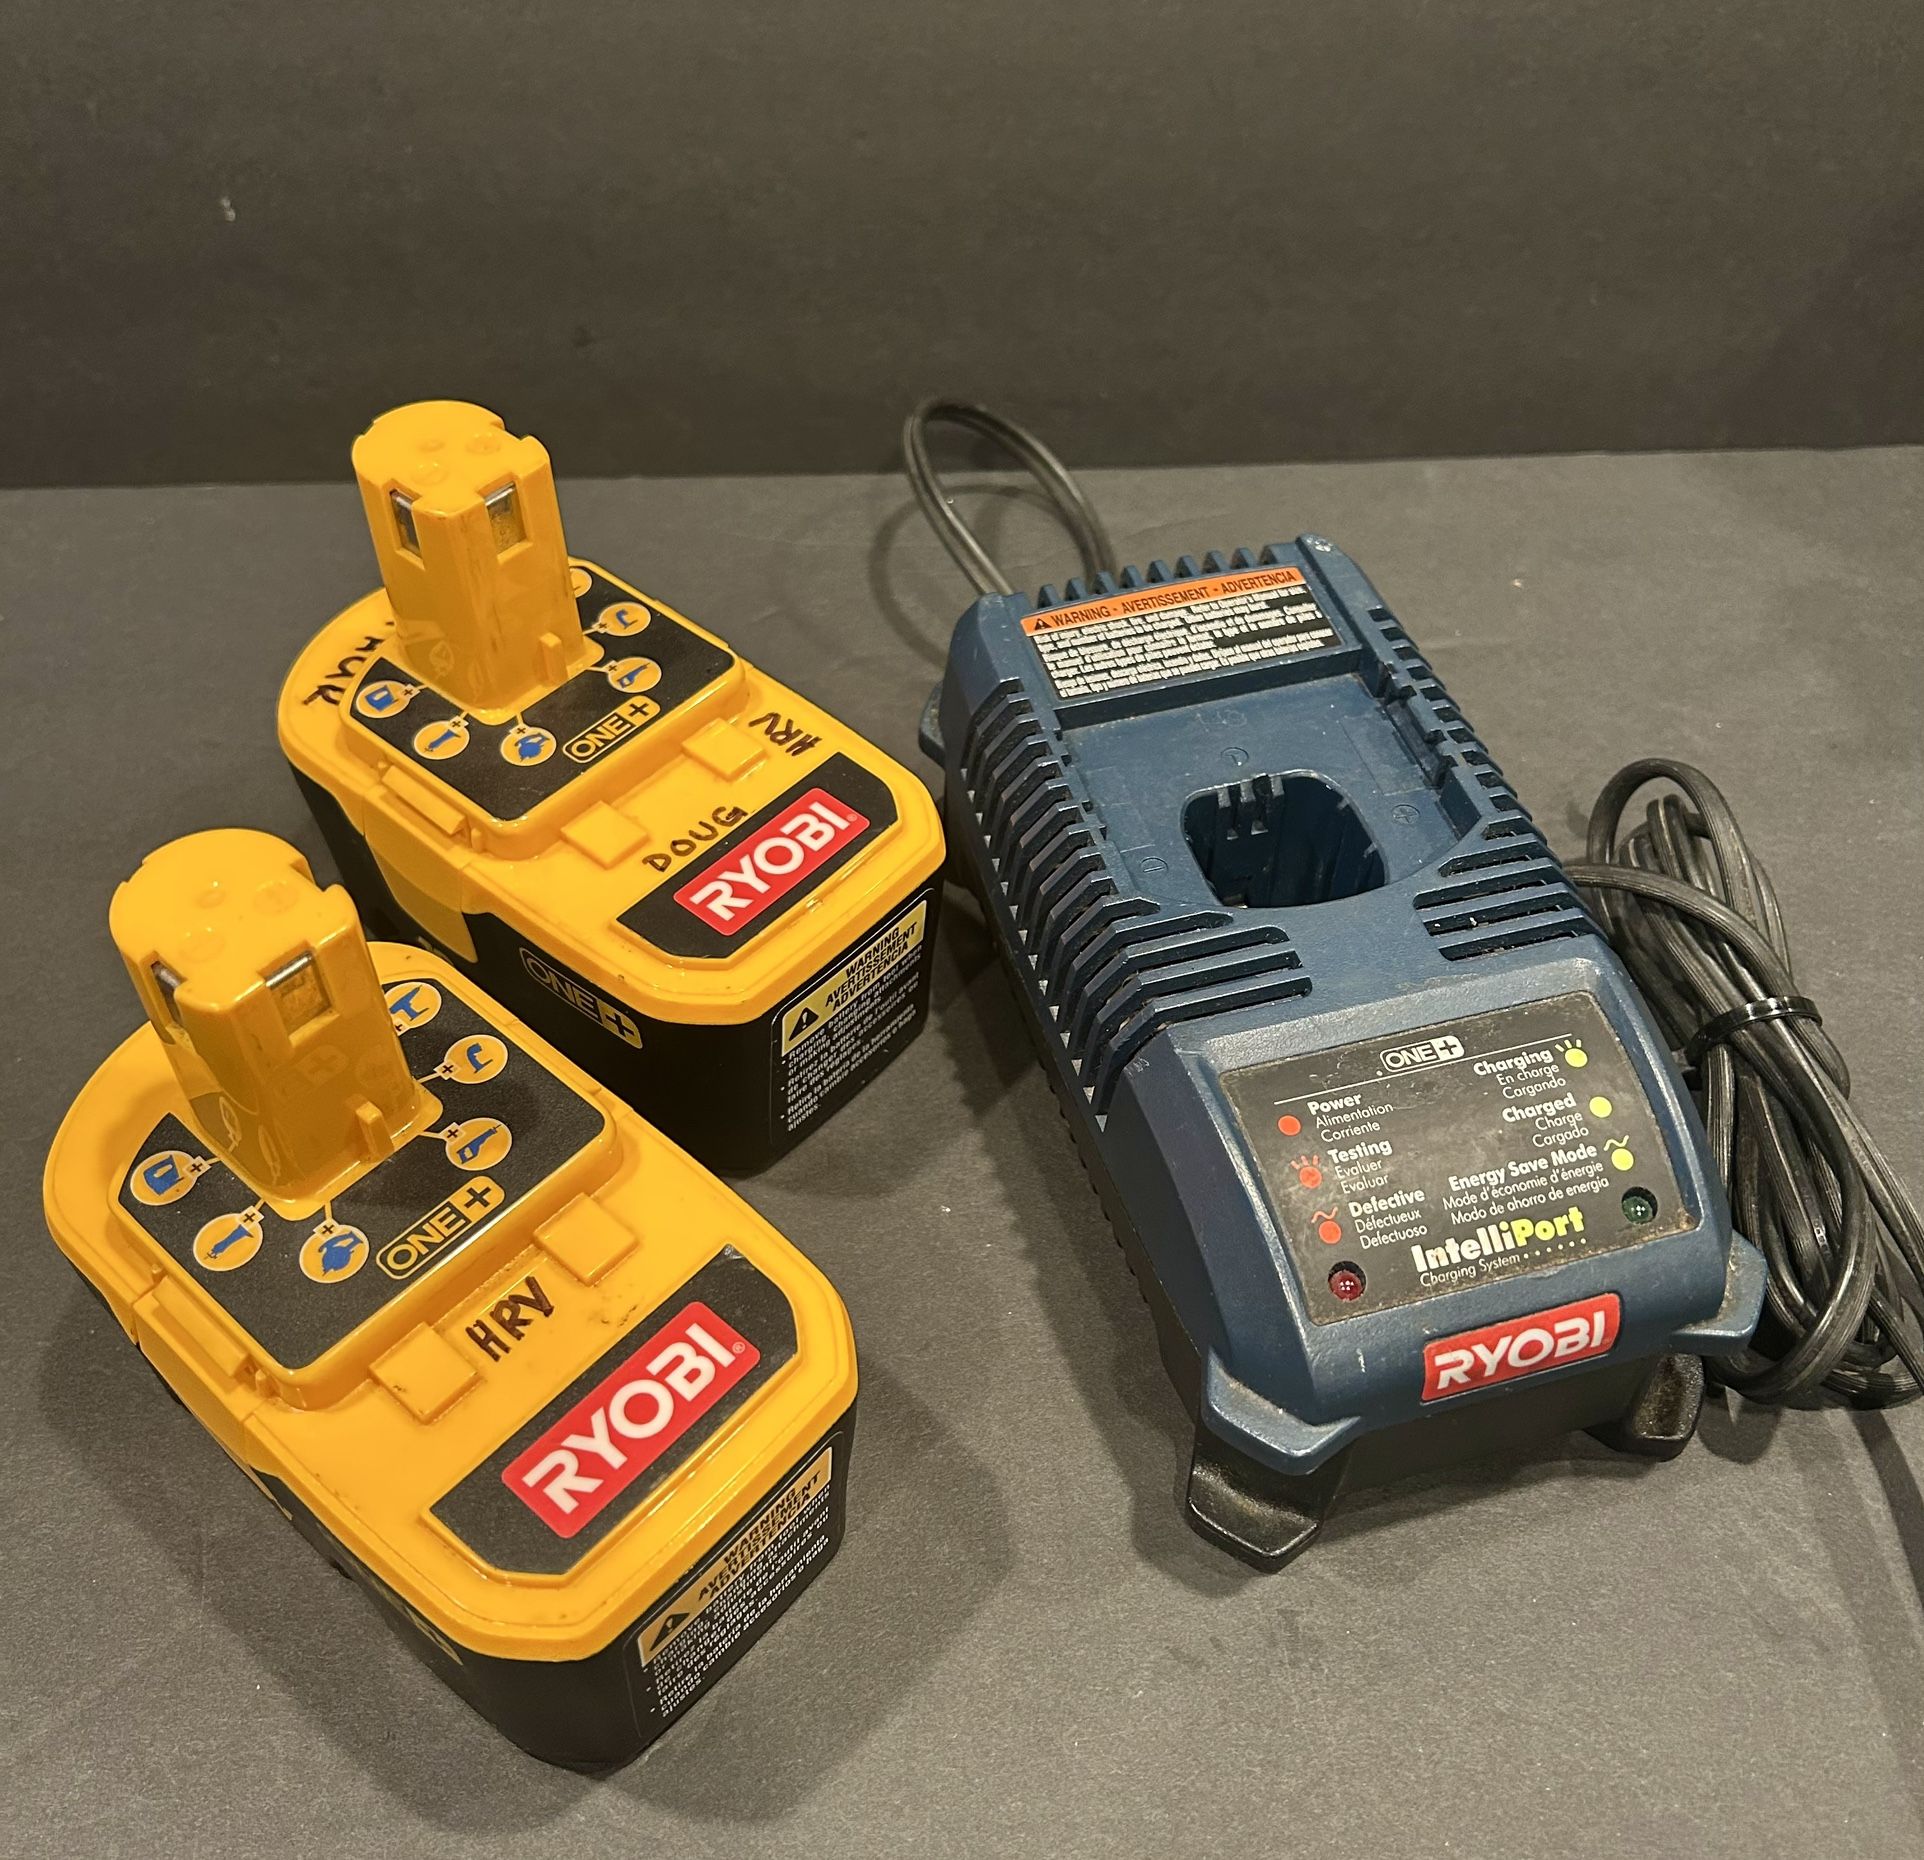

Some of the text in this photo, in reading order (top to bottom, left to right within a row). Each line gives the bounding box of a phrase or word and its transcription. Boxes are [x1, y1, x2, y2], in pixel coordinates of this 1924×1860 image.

[1051, 571, 1297, 628] WARNING AVERTISSEMENT ADVERTENCIA
[642, 805, 749, 873] DOUG
[689, 801, 850, 922] RYOBI
[825, 922, 916, 1006] AVERTISSEMENT
[846, 927, 898, 977] WARNING
[832, 941, 907, 1010] ADVERTENCIA
[1473, 1050, 1553, 1075] Charging
[1495, 1061, 1559, 1085] En charge
[1307, 1094, 1360, 1114] Power
[1502, 1075, 1565, 1098] Cargando
[1316, 1104, 1393, 1128] Alimentation
[1502, 1092, 1576, 1121] Charged
[1320, 1121, 1380, 1142] Corriente
[1532, 1124, 1588, 1147] Cargado
[1327, 1141, 1391, 1168] Testing
[1335, 1160, 1381, 1179] Evaluer
[1448, 1143, 1596, 1190] Energy Save Mode
[1341, 1174, 1387, 1193] Evaluar
[1442, 1191, 1477, 1209] Mode
[1550, 1161, 1603, 1182] d'énergie
[1348, 1190, 1424, 1216] Defective
[1354, 1210, 1420, 1232] Défectueux
[1450, 1205, 1486, 1224] Modo
[1489, 1201, 1504, 1215] de
[1506, 1194, 1545, 1210] ahorro
[1548, 1186, 1563, 1200] de
[1359, 1225, 1427, 1248] Defectuoso
[1412, 1208, 1582, 1270] IntelliPort
[1478, 1254, 1520, 1271] System
[465, 1276, 555, 1362] HRV
[1435, 1310, 1607, 1390] RYOBI
[522, 1322, 736, 1515] RYOBI
[698, 1474, 817, 1599] AVERTISSEMENT
[724, 1488, 795, 1562] WARNING
[710, 1493, 809, 1598] ADVERTENCIA
